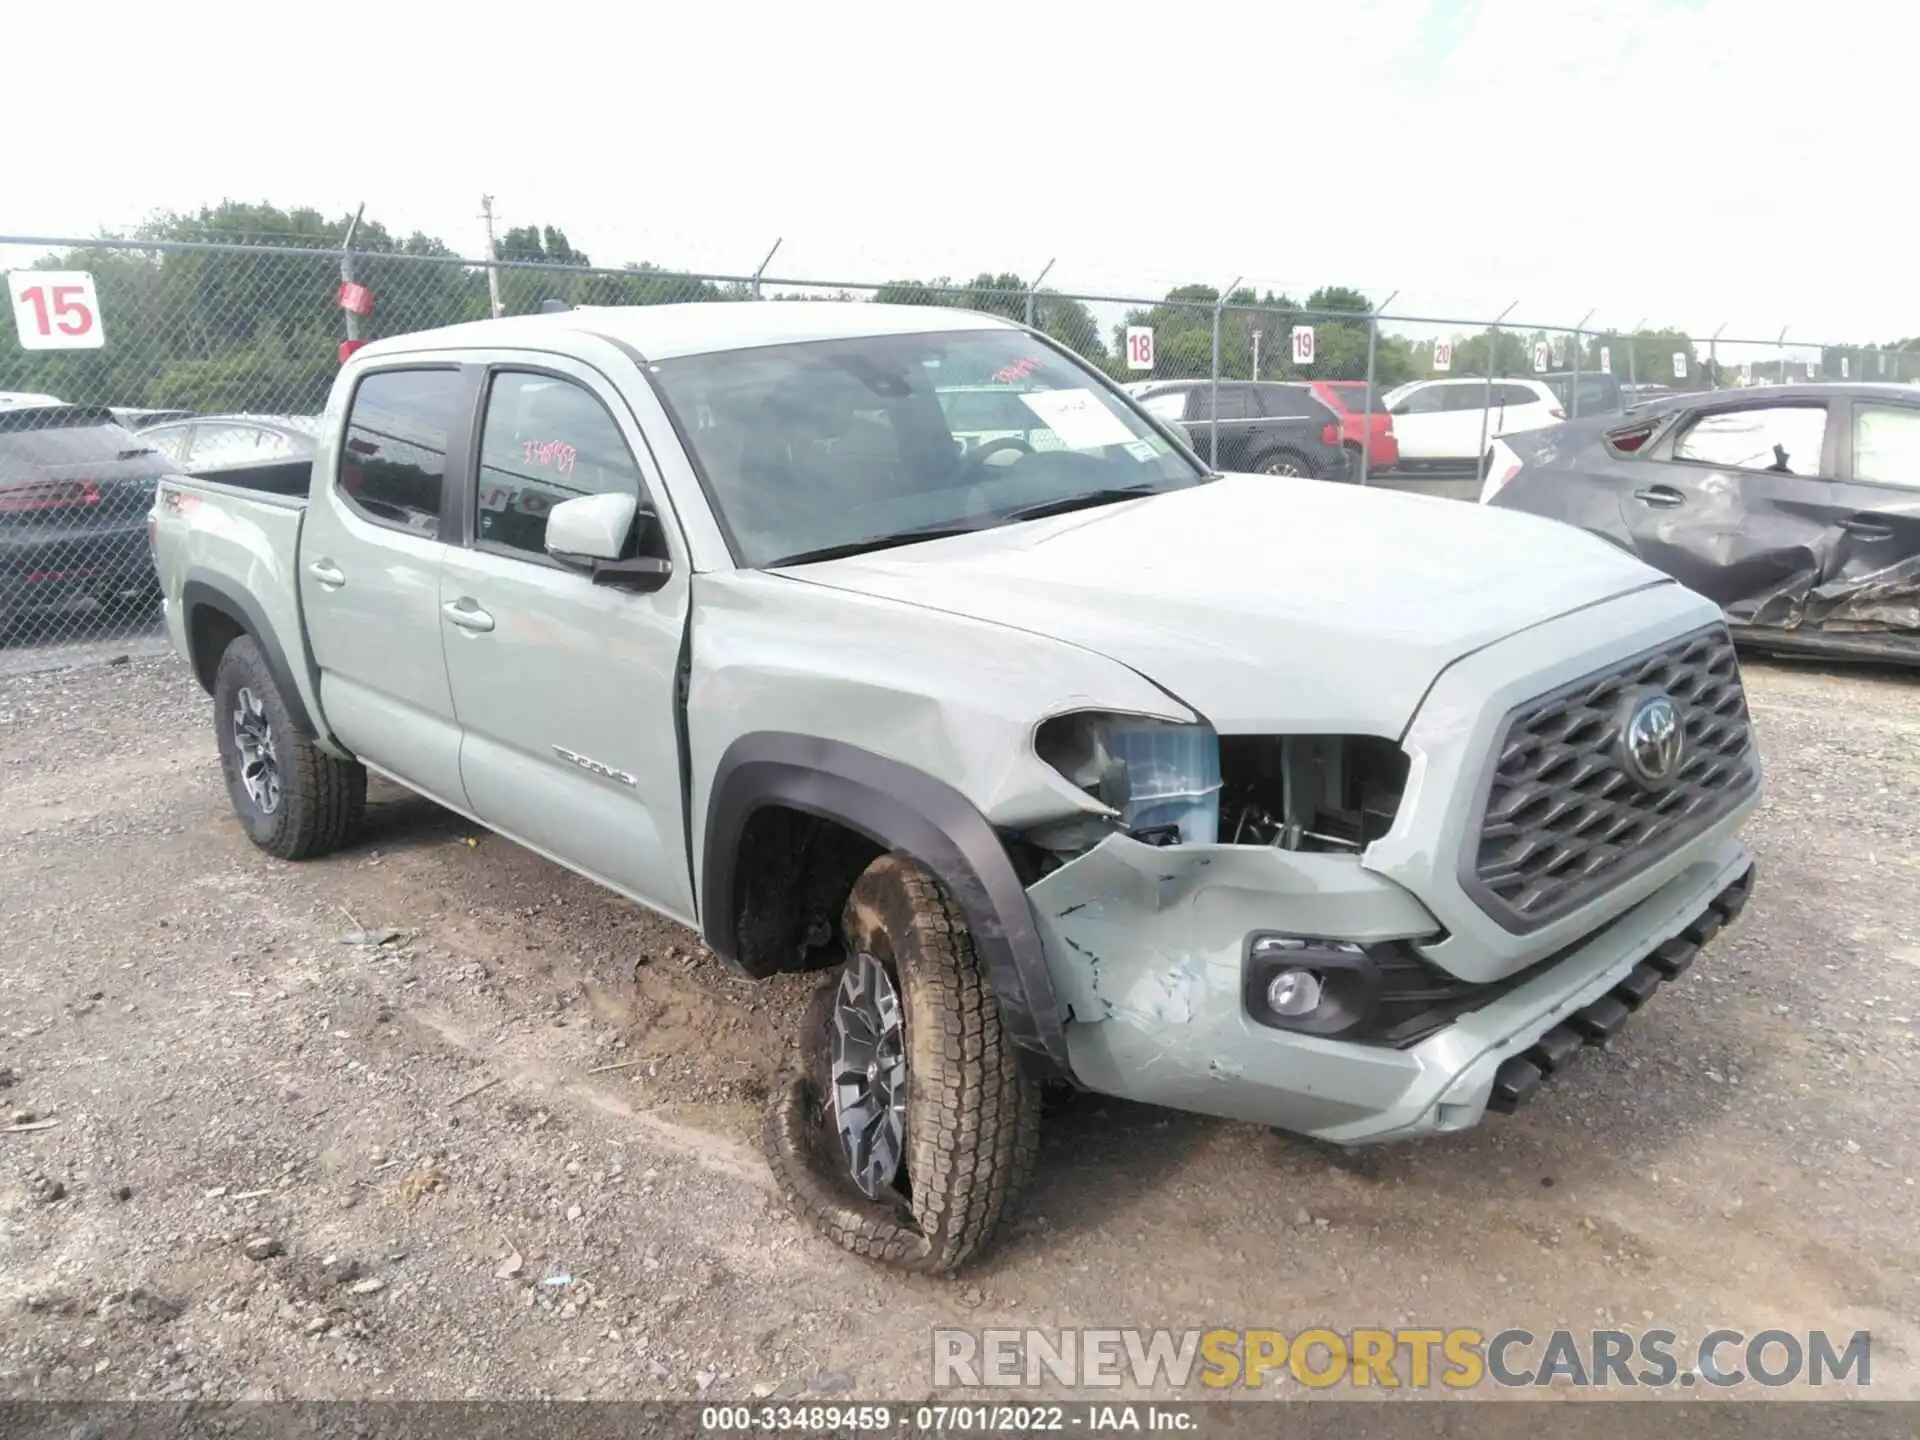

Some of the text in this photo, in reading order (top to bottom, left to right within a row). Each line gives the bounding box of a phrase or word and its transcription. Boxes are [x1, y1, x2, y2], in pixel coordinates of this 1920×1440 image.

[19, 285, 93, 336] 15
[1128, 334, 1151, 362] 18
[1294, 332, 1313, 359] 19
[1435, 344, 1450, 364] 20
